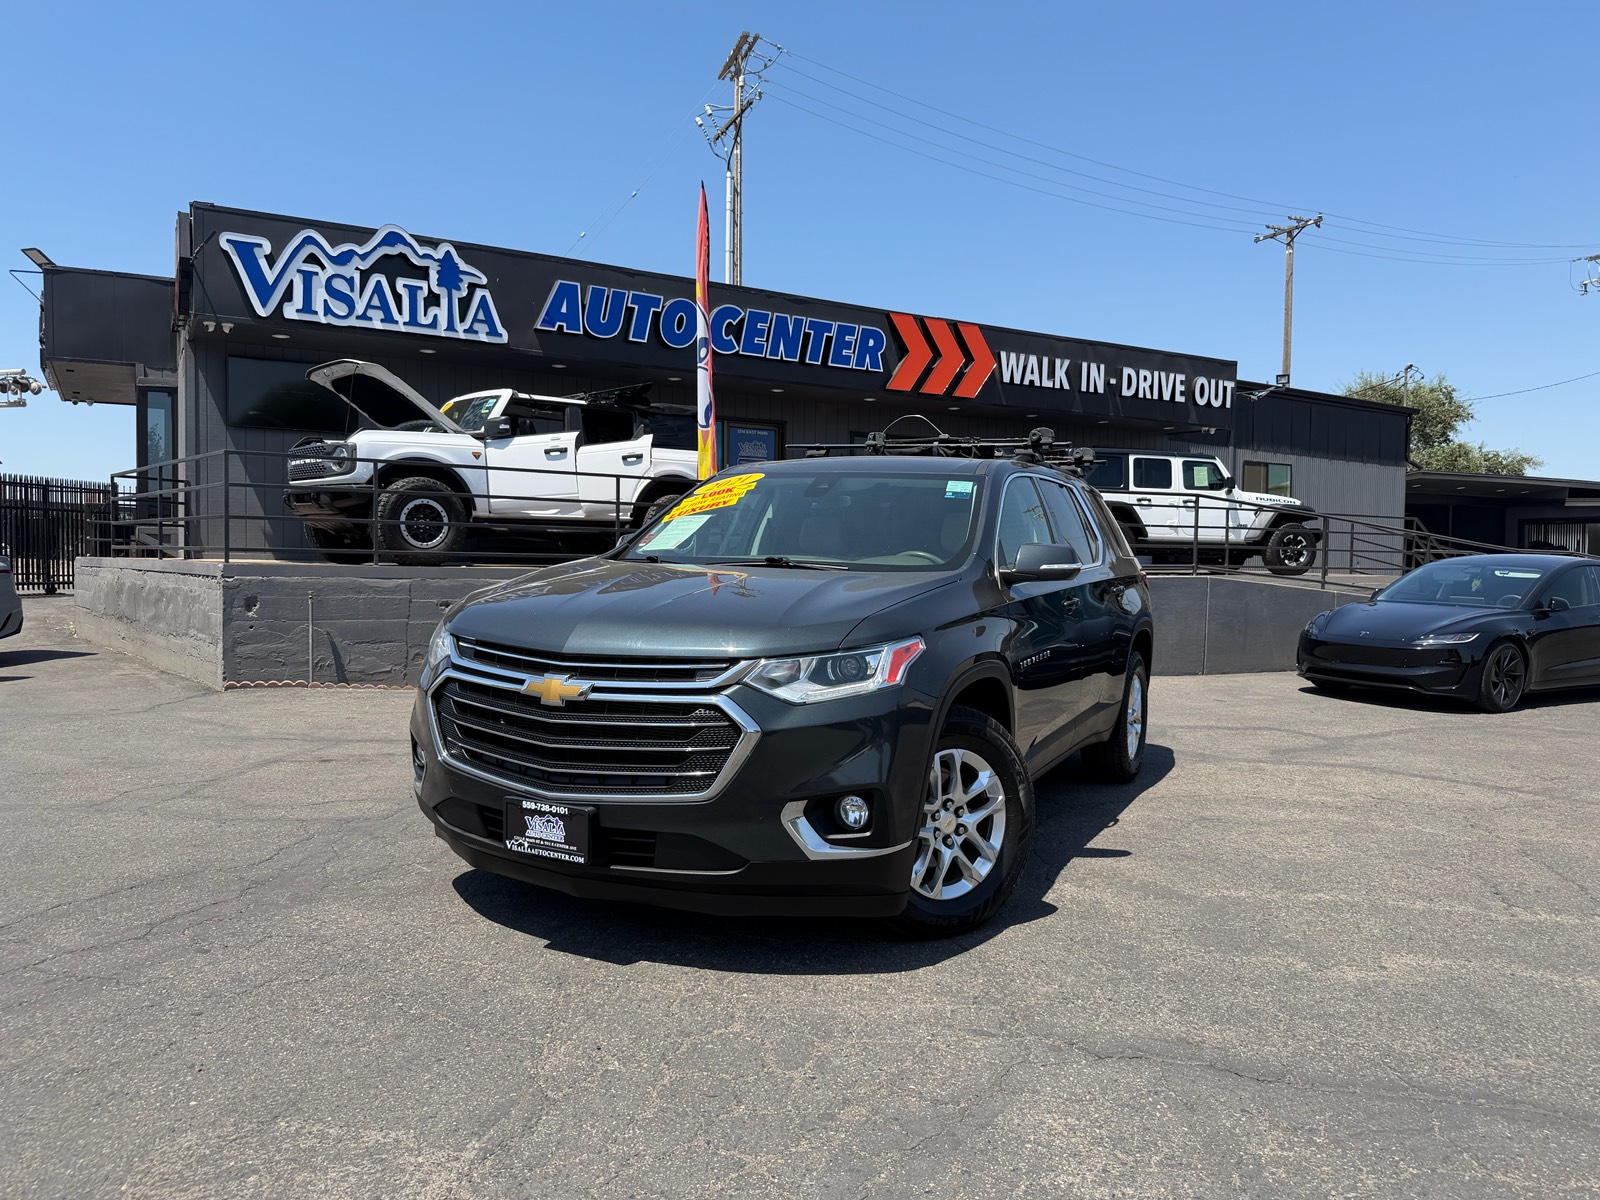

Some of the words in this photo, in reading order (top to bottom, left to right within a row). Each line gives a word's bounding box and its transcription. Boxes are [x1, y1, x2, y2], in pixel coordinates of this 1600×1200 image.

[219, 225, 508, 343] VISALIA
[534, 280, 698, 348] AUTO
[709, 304, 886, 372] CENTER
[1000, 350, 1071, 390] WALK
[1194, 376, 1235, 409] OUT
[701, 486, 735, 499] LOOK
[1255, 496, 1296, 504] RUBICON
[668, 499, 735, 520] LUXURY
[522, 800, 568, 815] 559-738-0101
[524, 814, 566, 836] VISALIA
[525, 829, 542, 839] AUTO
[541, 832, 565, 843] CENTER
